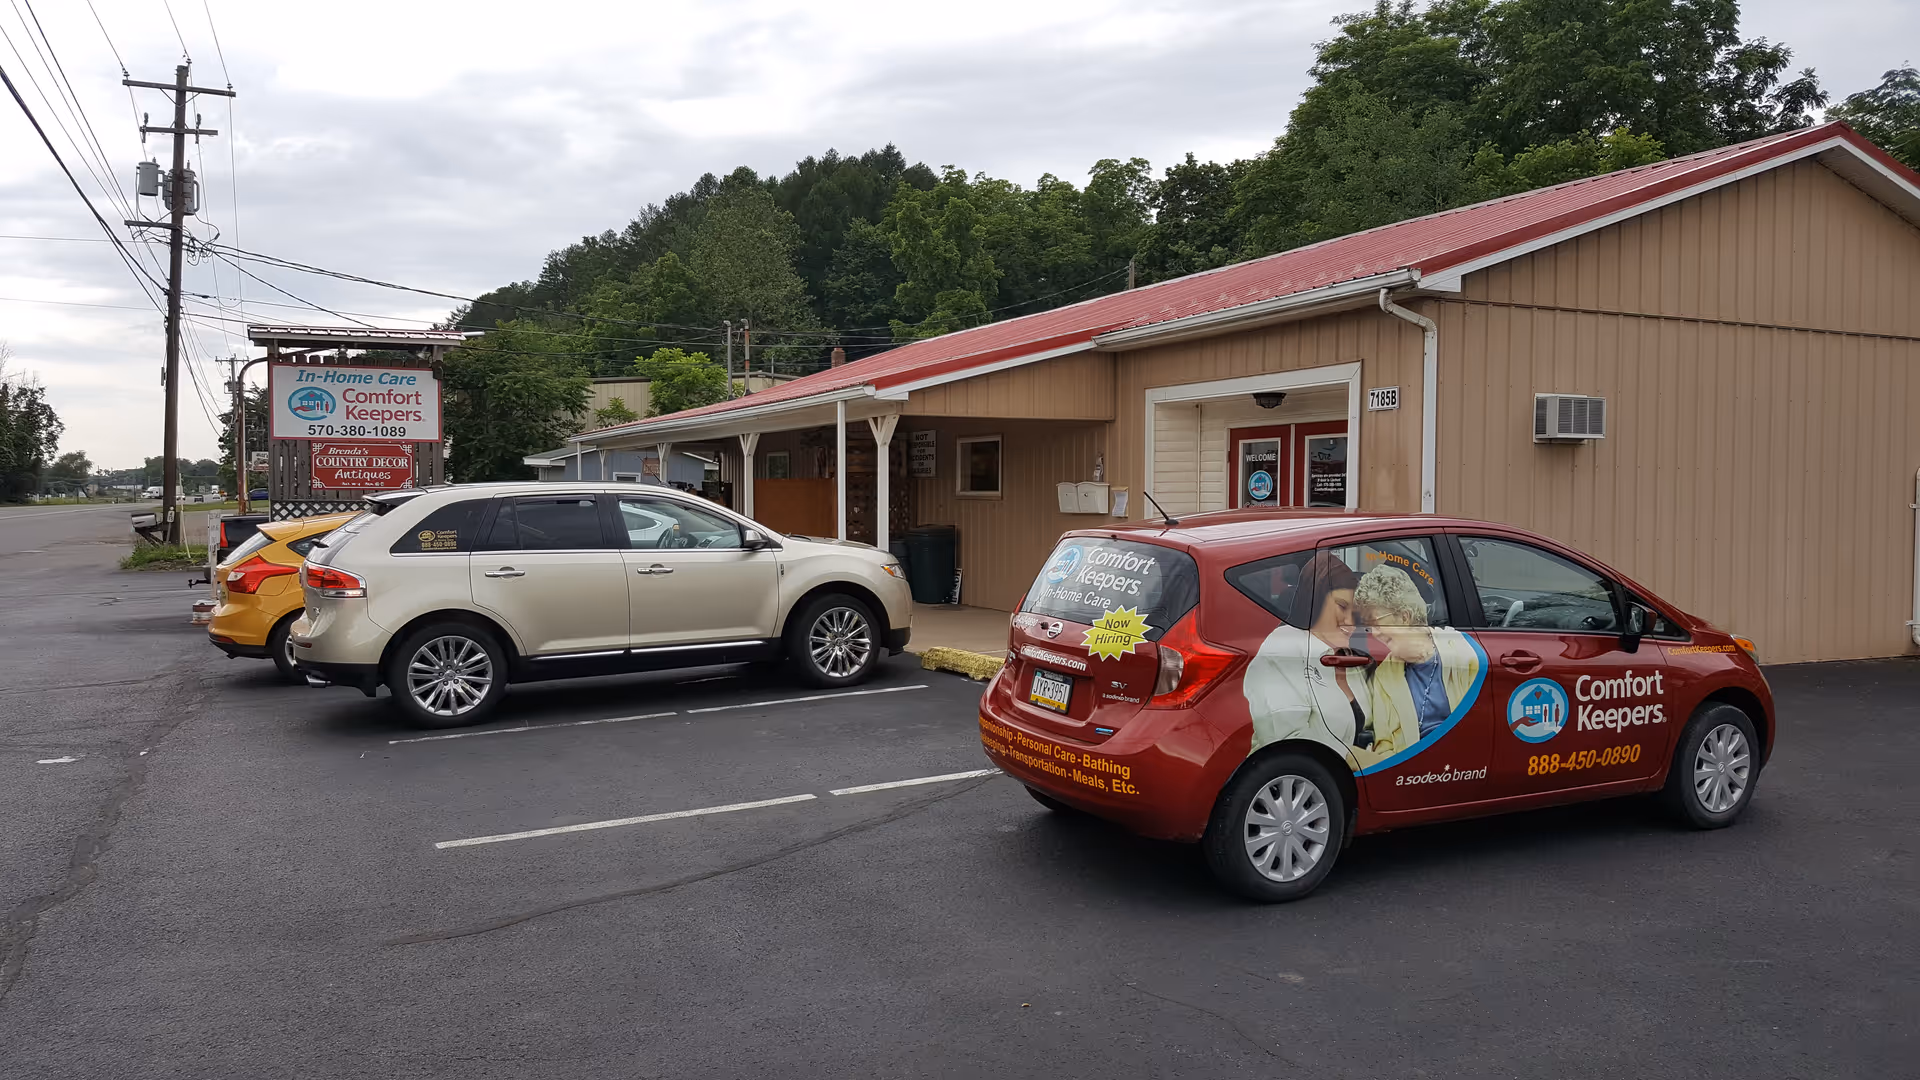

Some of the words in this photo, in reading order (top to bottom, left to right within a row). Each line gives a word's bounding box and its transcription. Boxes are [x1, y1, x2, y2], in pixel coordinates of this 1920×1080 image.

[296, 369, 373, 384] In-Home
[378, 372, 417, 386] Care
[342, 388, 422, 405] Comfort
[1370, 390, 1397, 407] 7185B
[308, 424, 407, 437] 570-380-1089
[328, 447, 369, 455] Brenda's
[1245, 453, 1277, 462] WELCOME
[316, 457, 368, 467] COUNTRY
[372, 458, 409, 467] DECOR
[334, 469, 391, 481] Antiques
[1087, 546, 1156, 575] Comfort
[1365, 550, 1410, 567] In-Home
[1412, 562, 1435, 585] Care
[1045, 585, 1083, 602] In-Home
[1083, 591, 1111, 609] Care
[1104, 619, 1131, 630] Now
[1095, 633, 1132, 646] Hiring
[1021, 645, 1087, 671] ComfortKeepers.com
[1667, 645, 1736, 656] ComfortKeepers.com
[1111, 681, 1128, 689] SV
[1575, 669, 1664, 701] Comfort
[1017, 732, 1052, 756] Personal
[1054, 745, 1076, 763] Care
[1083, 753, 1131, 780] Bathing
[1527, 744, 1641, 776] 888-450-0890
[1008, 745, 1067, 778] Transportation
[1072, 769, 1109, 792] Meals,
[1112, 778, 1140, 795] Etc.
[1395, 775, 1404, 786] a
[1404, 764, 1452, 785] sodexo
[1452, 765, 1487, 781] brand
